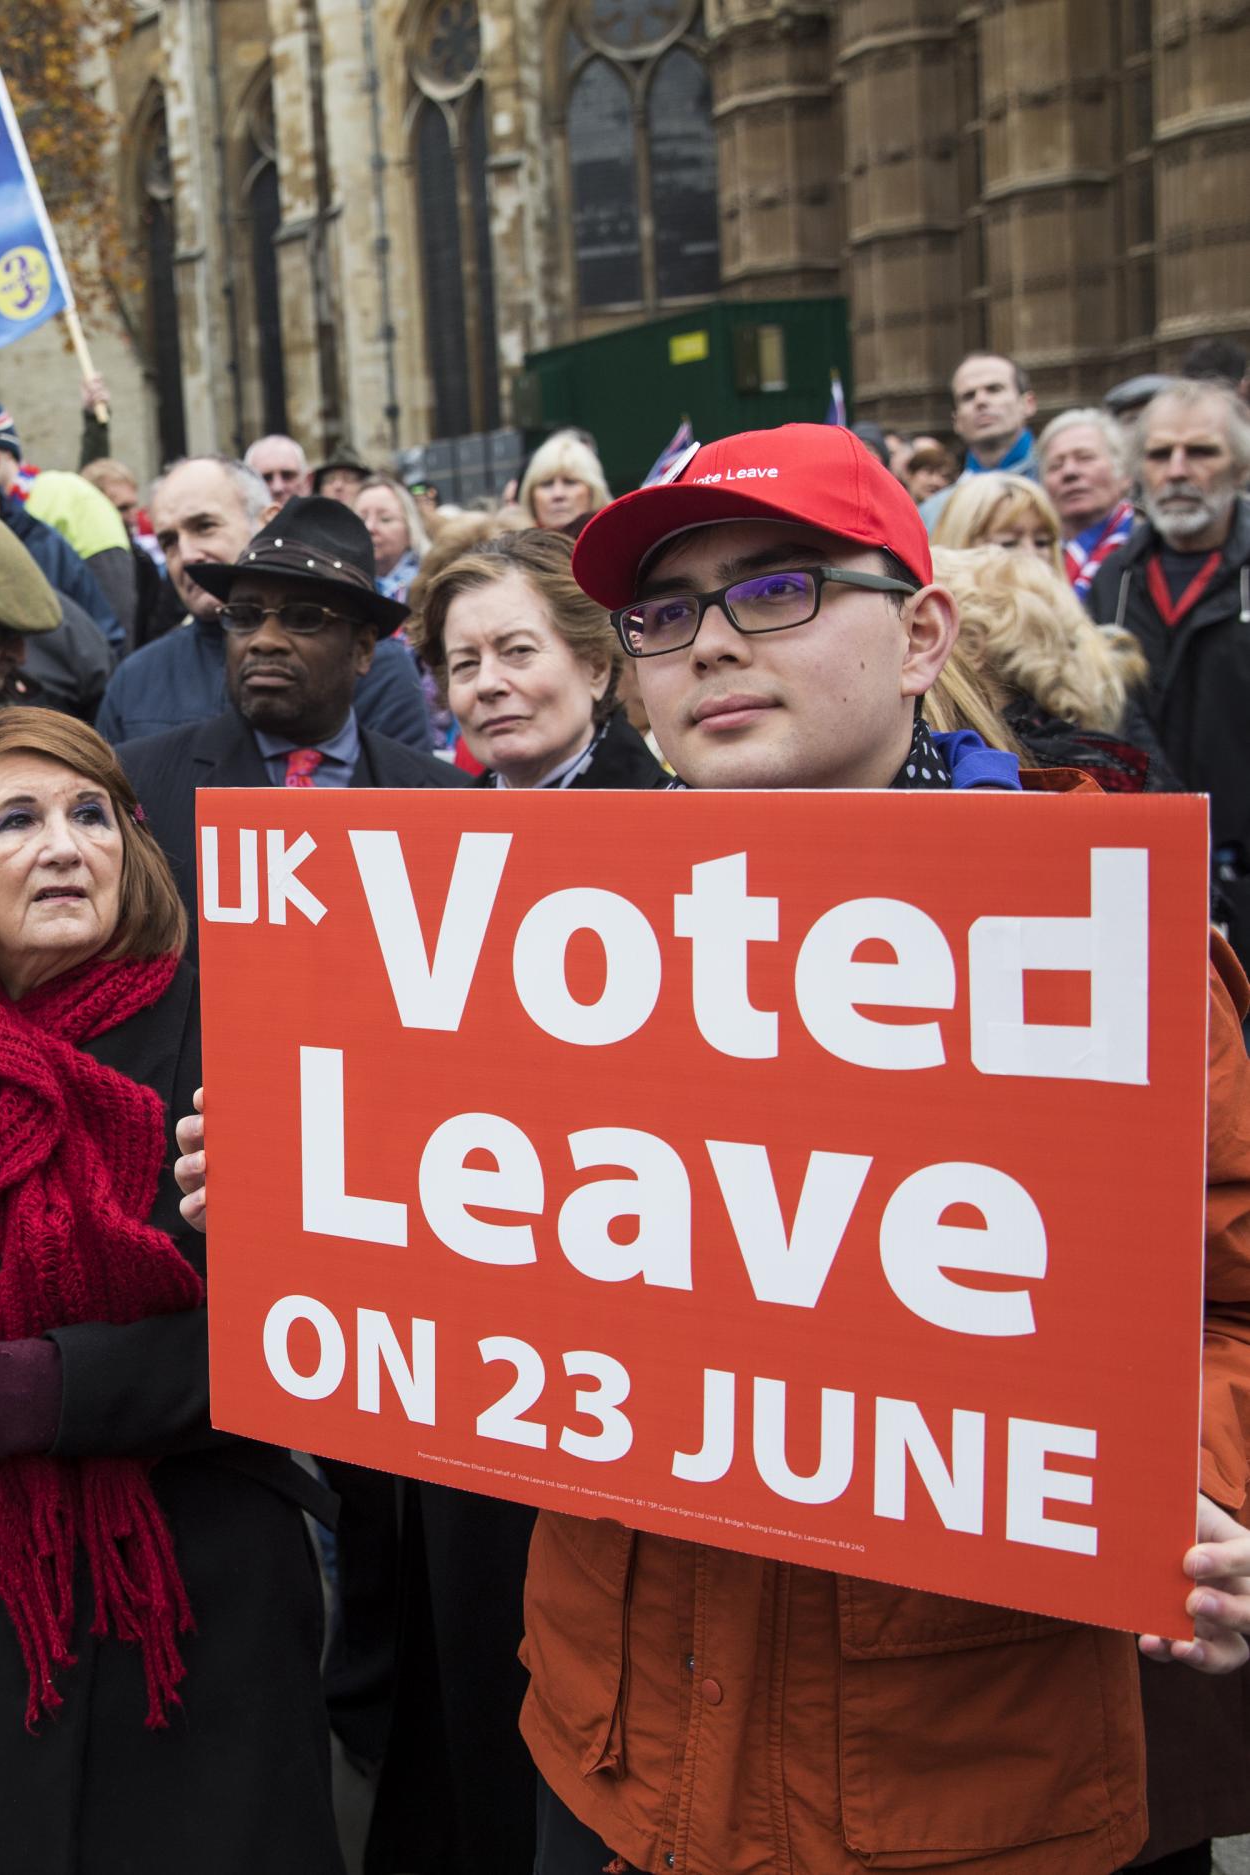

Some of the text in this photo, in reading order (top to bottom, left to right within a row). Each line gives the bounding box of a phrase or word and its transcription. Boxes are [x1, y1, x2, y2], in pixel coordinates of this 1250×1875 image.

[726, 467, 779, 481] Leave
[200, 826, 1150, 1086] UK Voted
[300, 1046, 1048, 1337] Leave
[263, 1294, 1098, 1556] ON 23 JUNE
[417, 1451, 441, 1461] Promoted
[449, 1458, 470, 1468] Matthew
[471, 1463, 486, 1472] Elliott
[493, 1469, 510, 1477] behalf
[518, 1473, 529, 1481] Vote
[530, 1476, 545, 1485] Leave
[556, 1482, 569, 1490] both
[581, 1487, 597, 1497] Albert
[636, 1498, 646, 1506] SE1
[659, 1503, 678, 1513] Carrick
[679, 1508, 694, 1517] Signs
[746, 1521, 767, 1533] Trading
[769, 1526, 787, 1536] Estate
[851, 1543, 865, 1552] 2AQ
